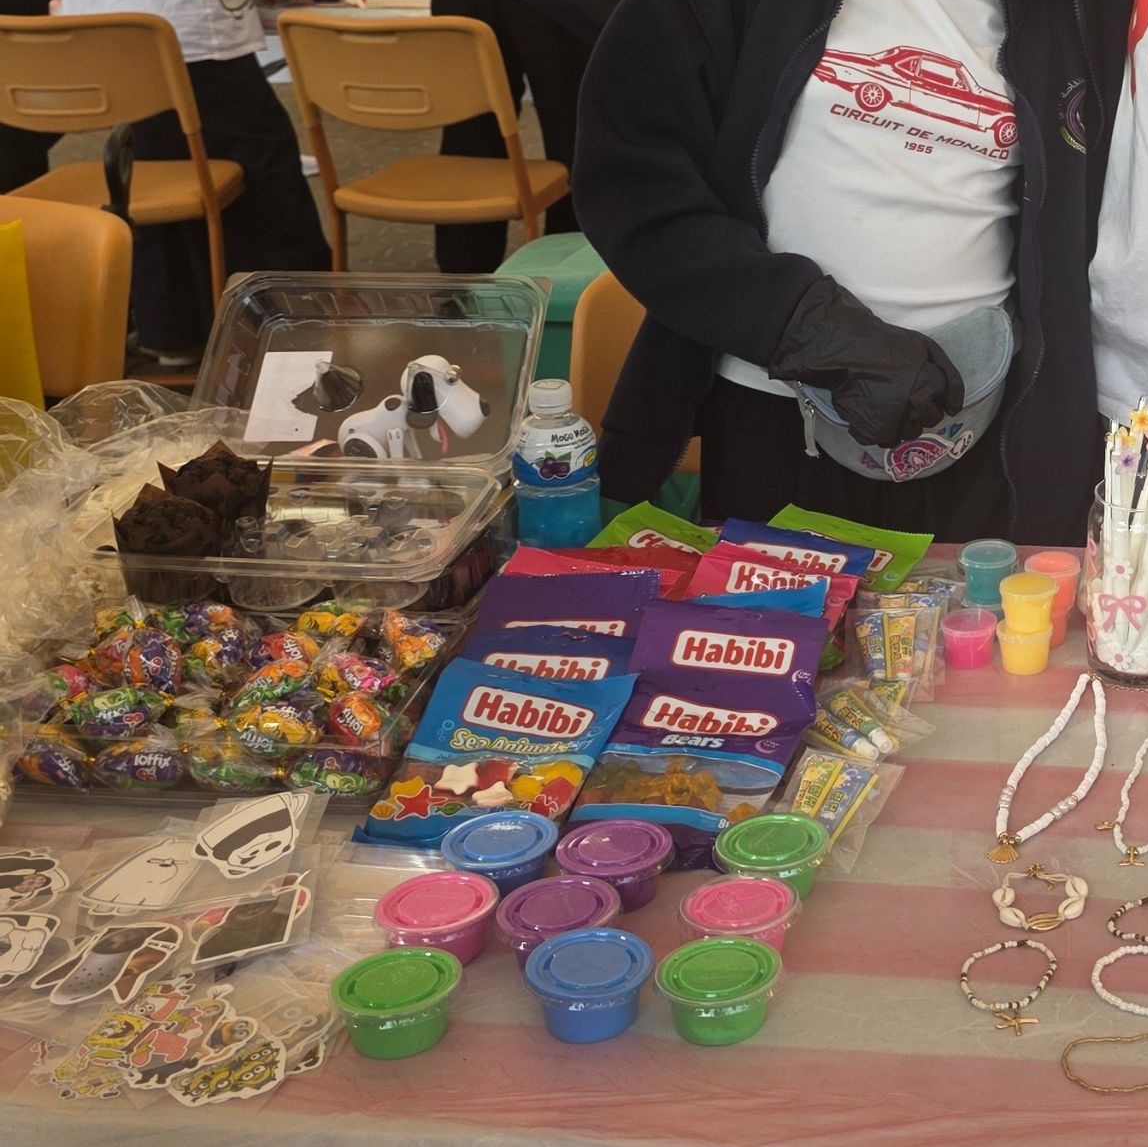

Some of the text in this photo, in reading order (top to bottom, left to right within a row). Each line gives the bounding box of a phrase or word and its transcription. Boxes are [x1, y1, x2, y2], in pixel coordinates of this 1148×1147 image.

[829, 102, 1010, 161] CIRCUIT DE MONACO
[904, 141, 934, 155] 1955
[682, 636, 788, 670] Habibi
[473, 691, 588, 734] Habibi
[653, 702, 770, 735] Habibi
[451, 728, 490, 751] Sea
[661, 734, 726, 748] Bears
